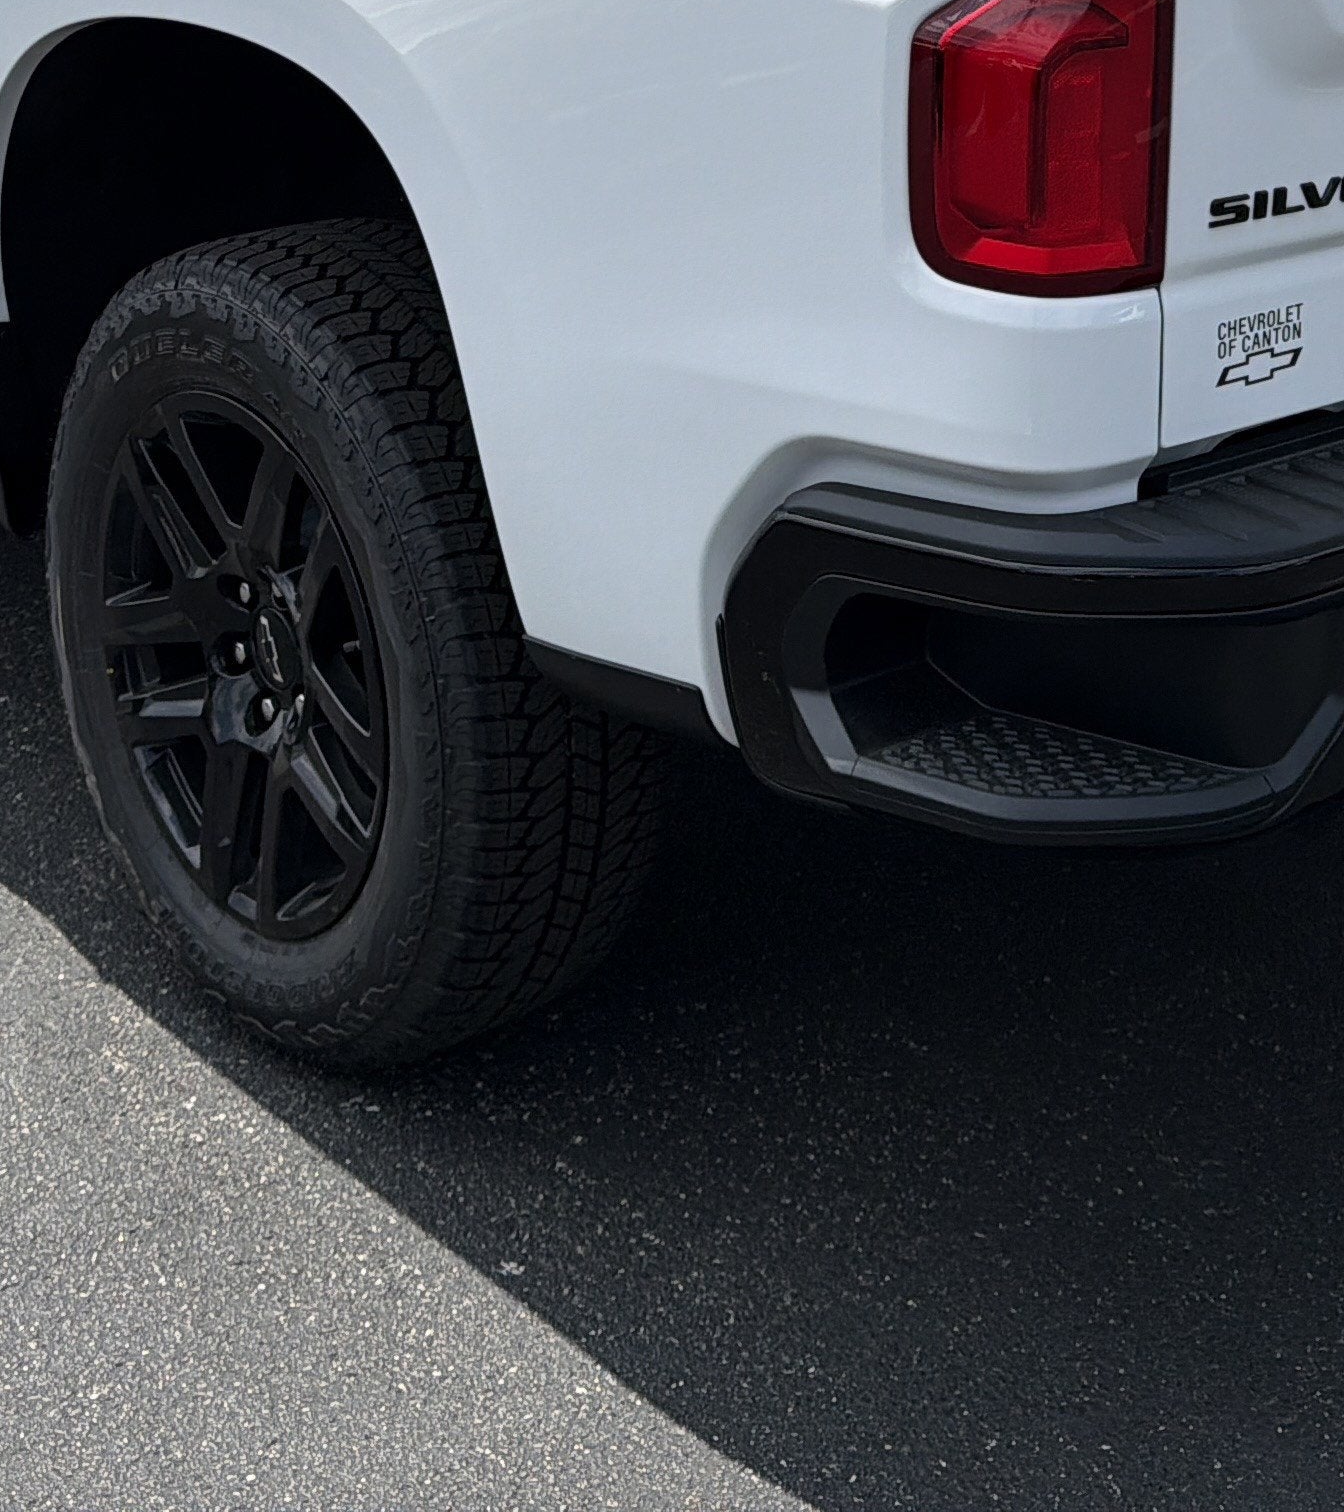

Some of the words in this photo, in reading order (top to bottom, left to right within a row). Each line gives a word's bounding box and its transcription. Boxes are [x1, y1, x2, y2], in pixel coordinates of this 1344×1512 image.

[1217, 303, 1304, 341] CHEVROLET
[1217, 337, 1236, 360] OF
[1242, 322, 1303, 353] CANTON
